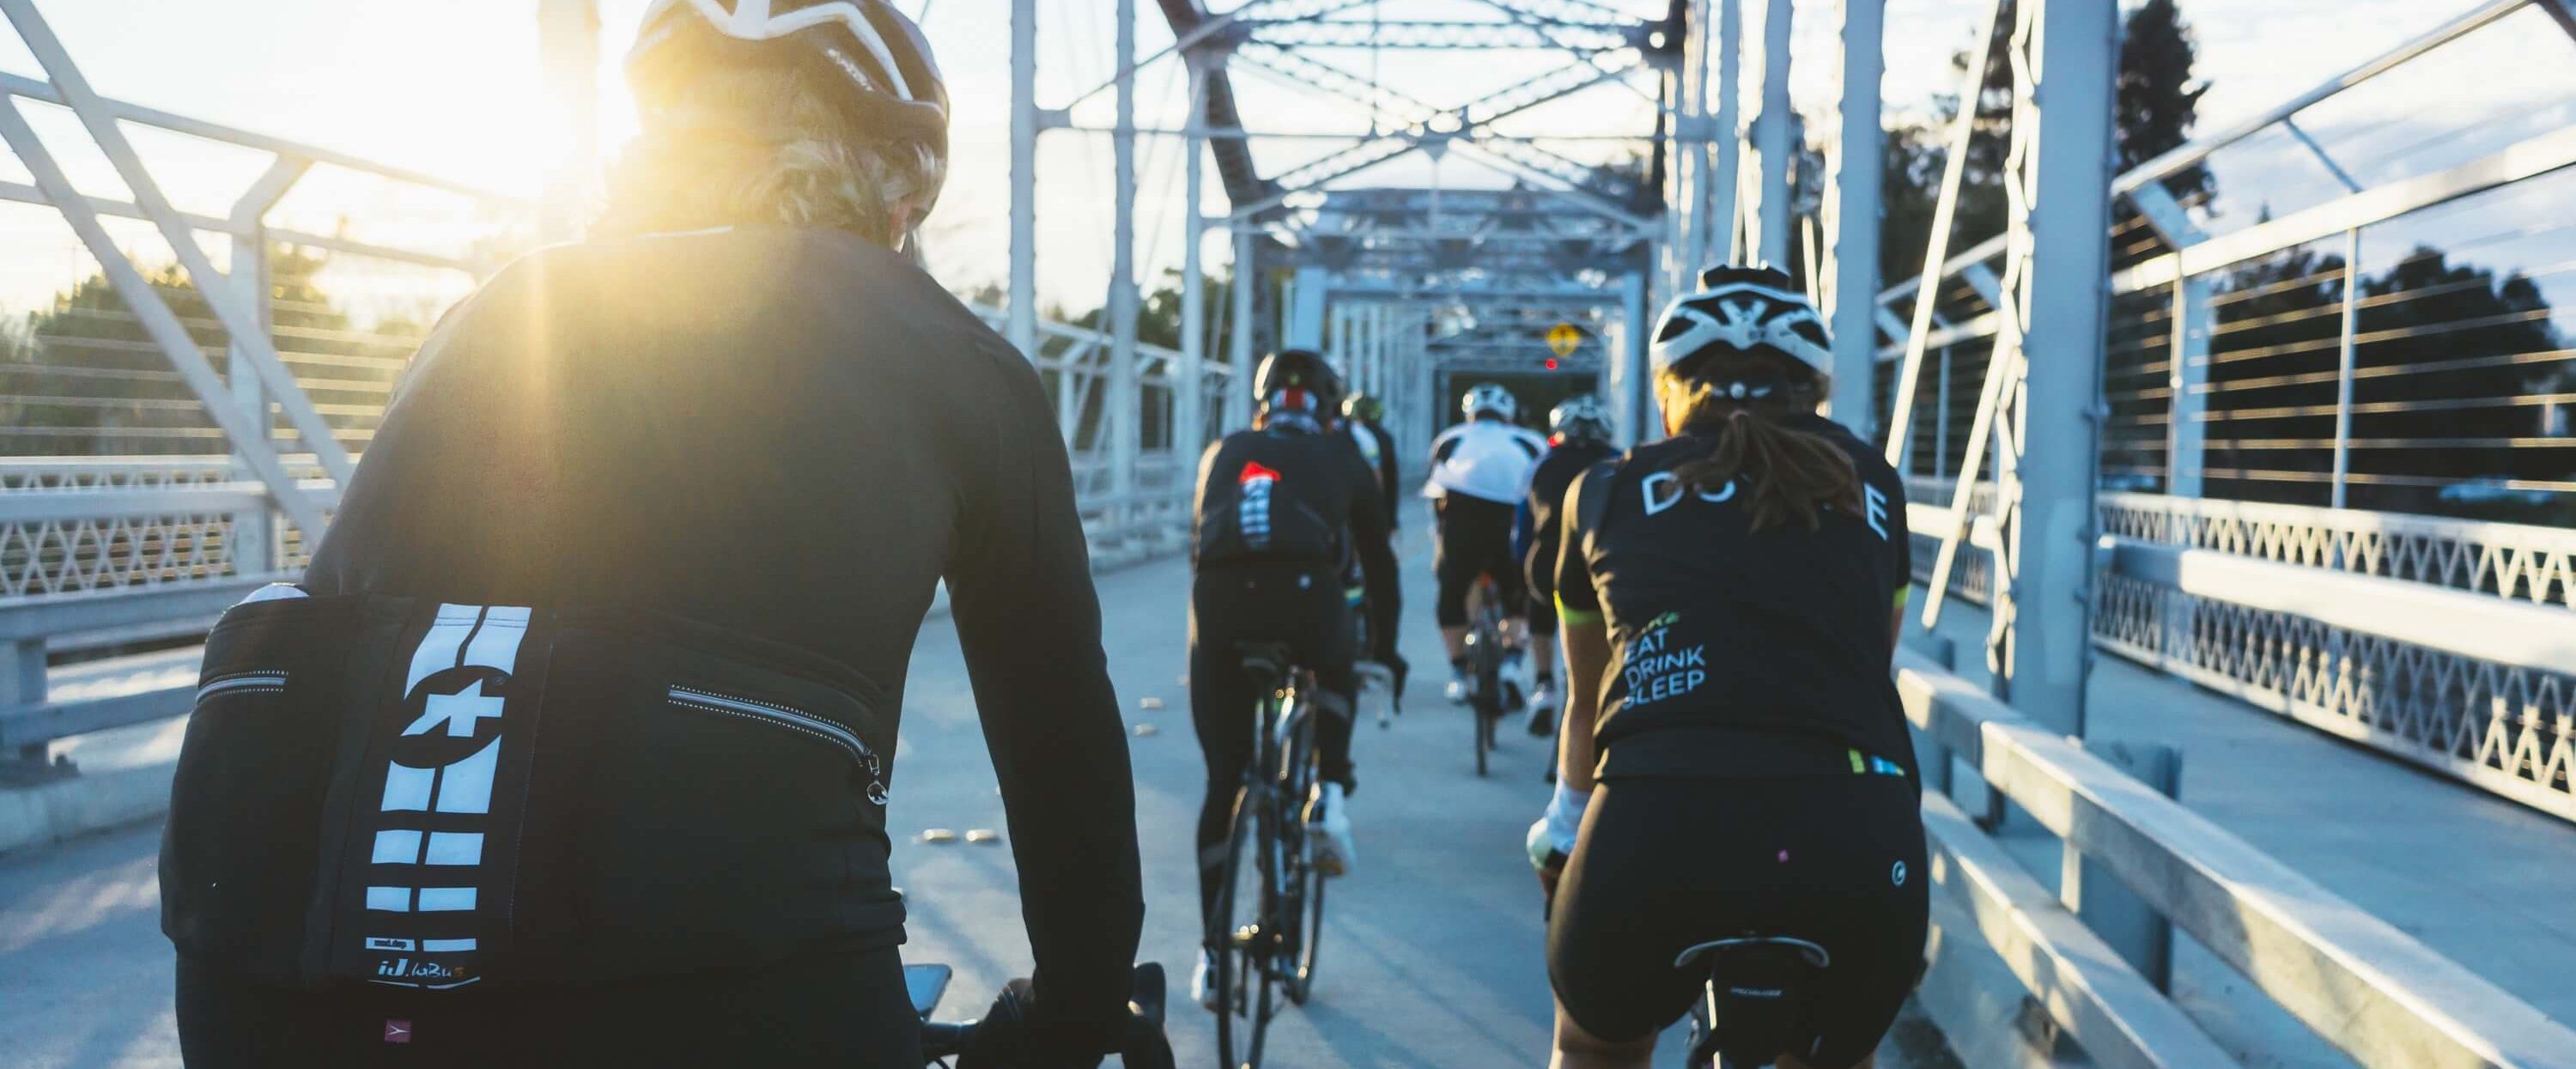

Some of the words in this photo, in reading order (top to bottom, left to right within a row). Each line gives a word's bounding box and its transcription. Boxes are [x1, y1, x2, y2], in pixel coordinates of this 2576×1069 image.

[1623, 627, 1669, 665] EAT
[1625, 645, 1706, 689] DRINK
[1621, 669, 1706, 711] SLEEP
